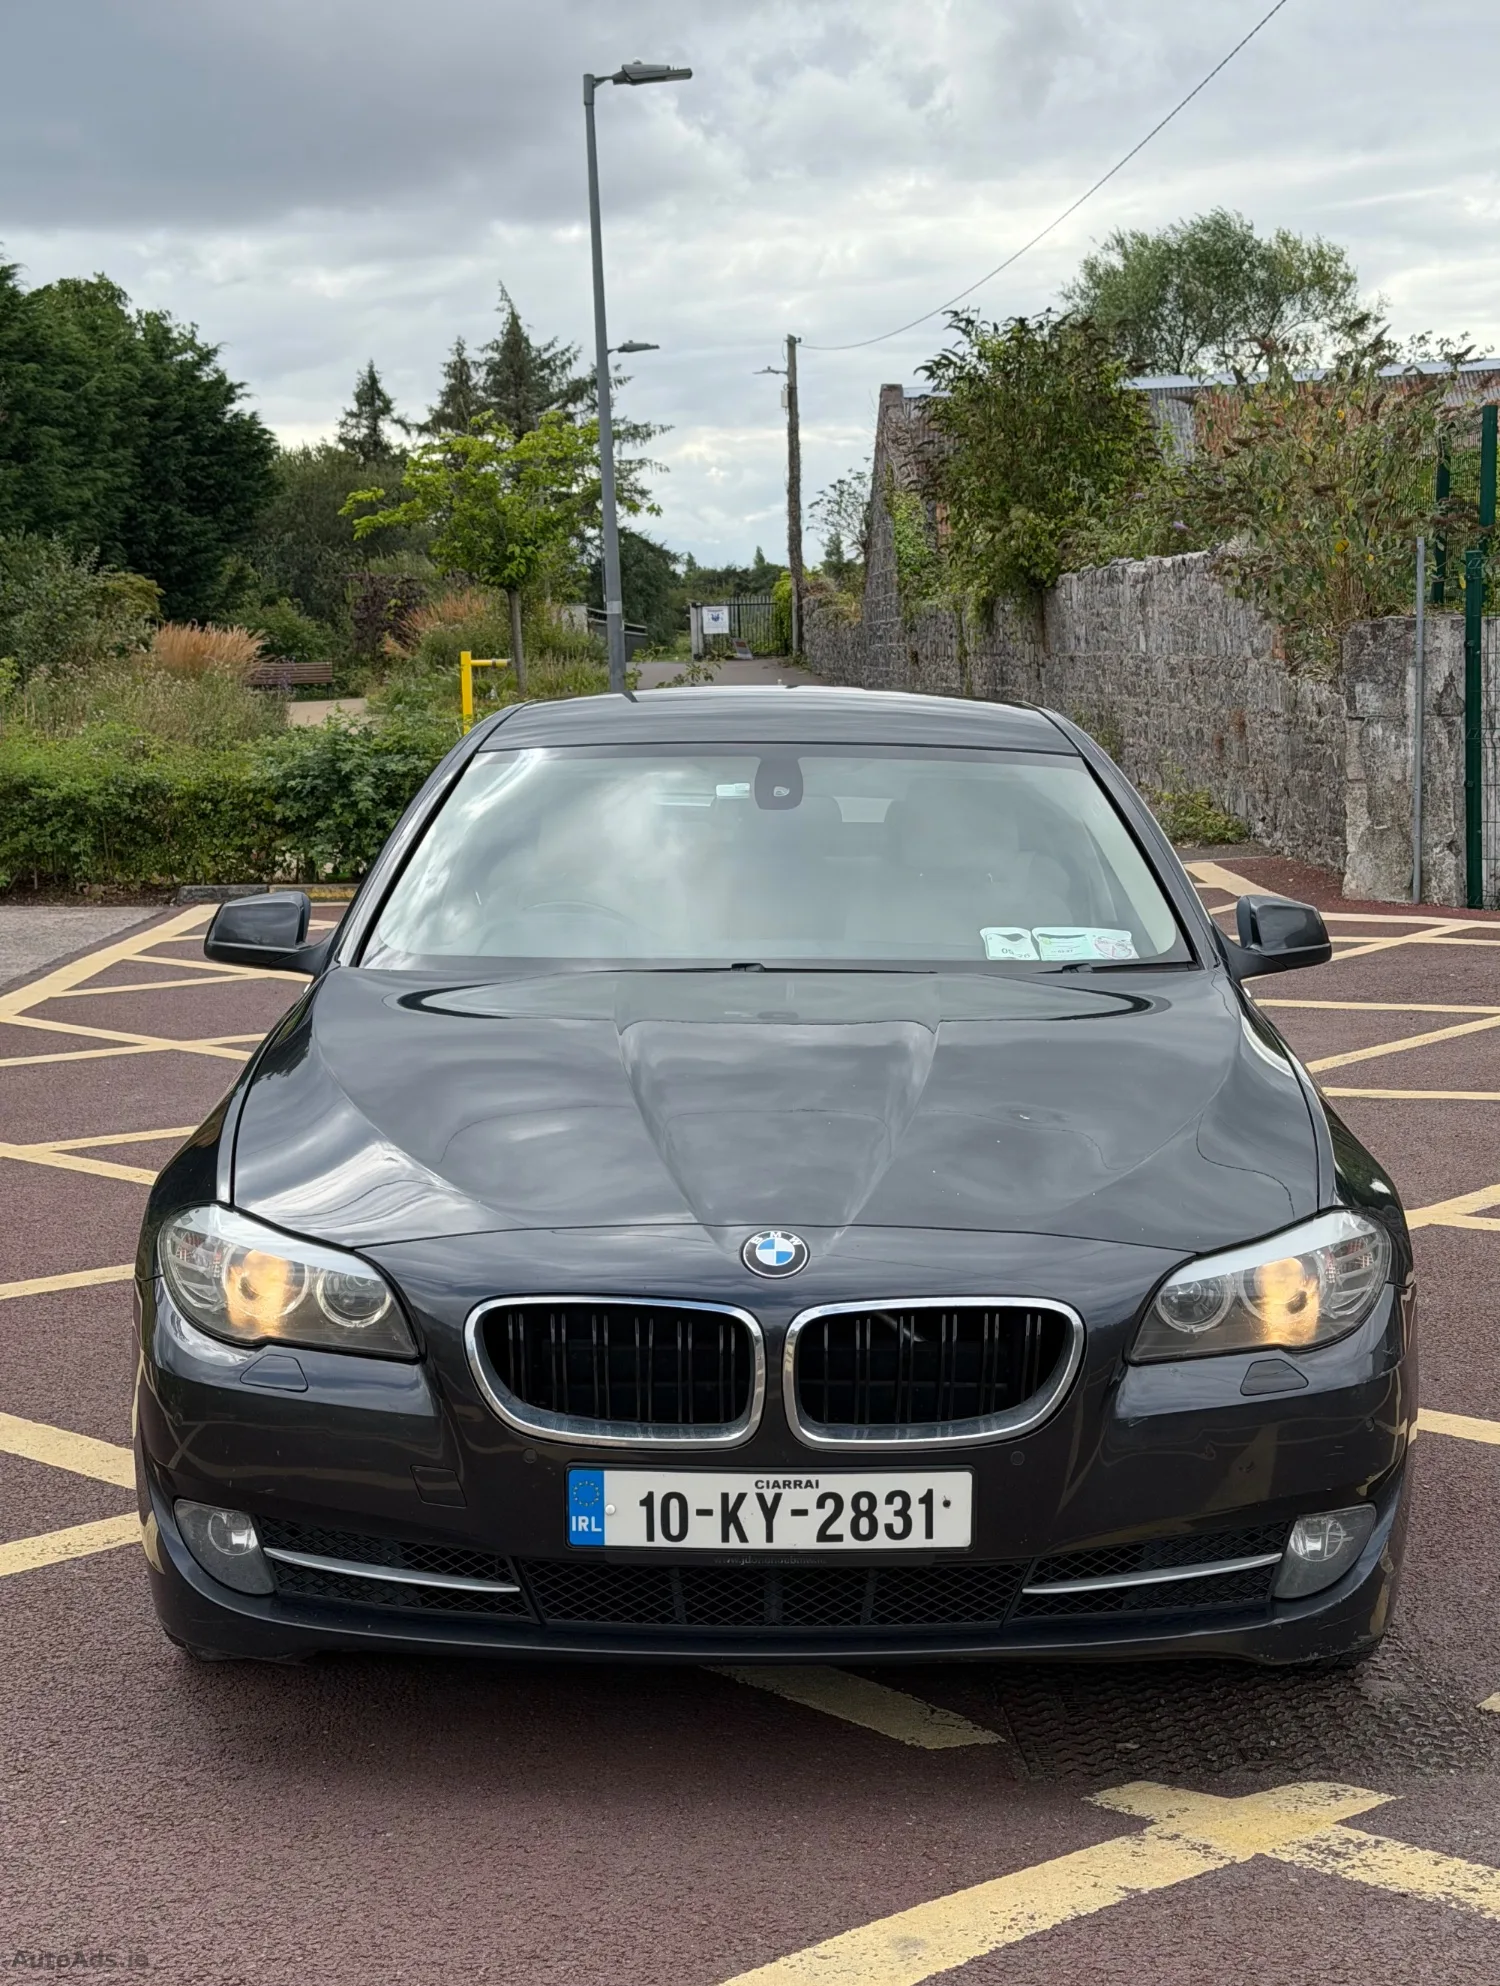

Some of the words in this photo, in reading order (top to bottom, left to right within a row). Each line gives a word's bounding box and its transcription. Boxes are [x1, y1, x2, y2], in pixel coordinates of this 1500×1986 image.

[750, 1231, 802, 1246] BMW
[754, 1479, 819, 1490] CIARRAI
[571, 1515, 602, 1532] IRL
[639, 1488, 934, 1544] 10-KY-2831
